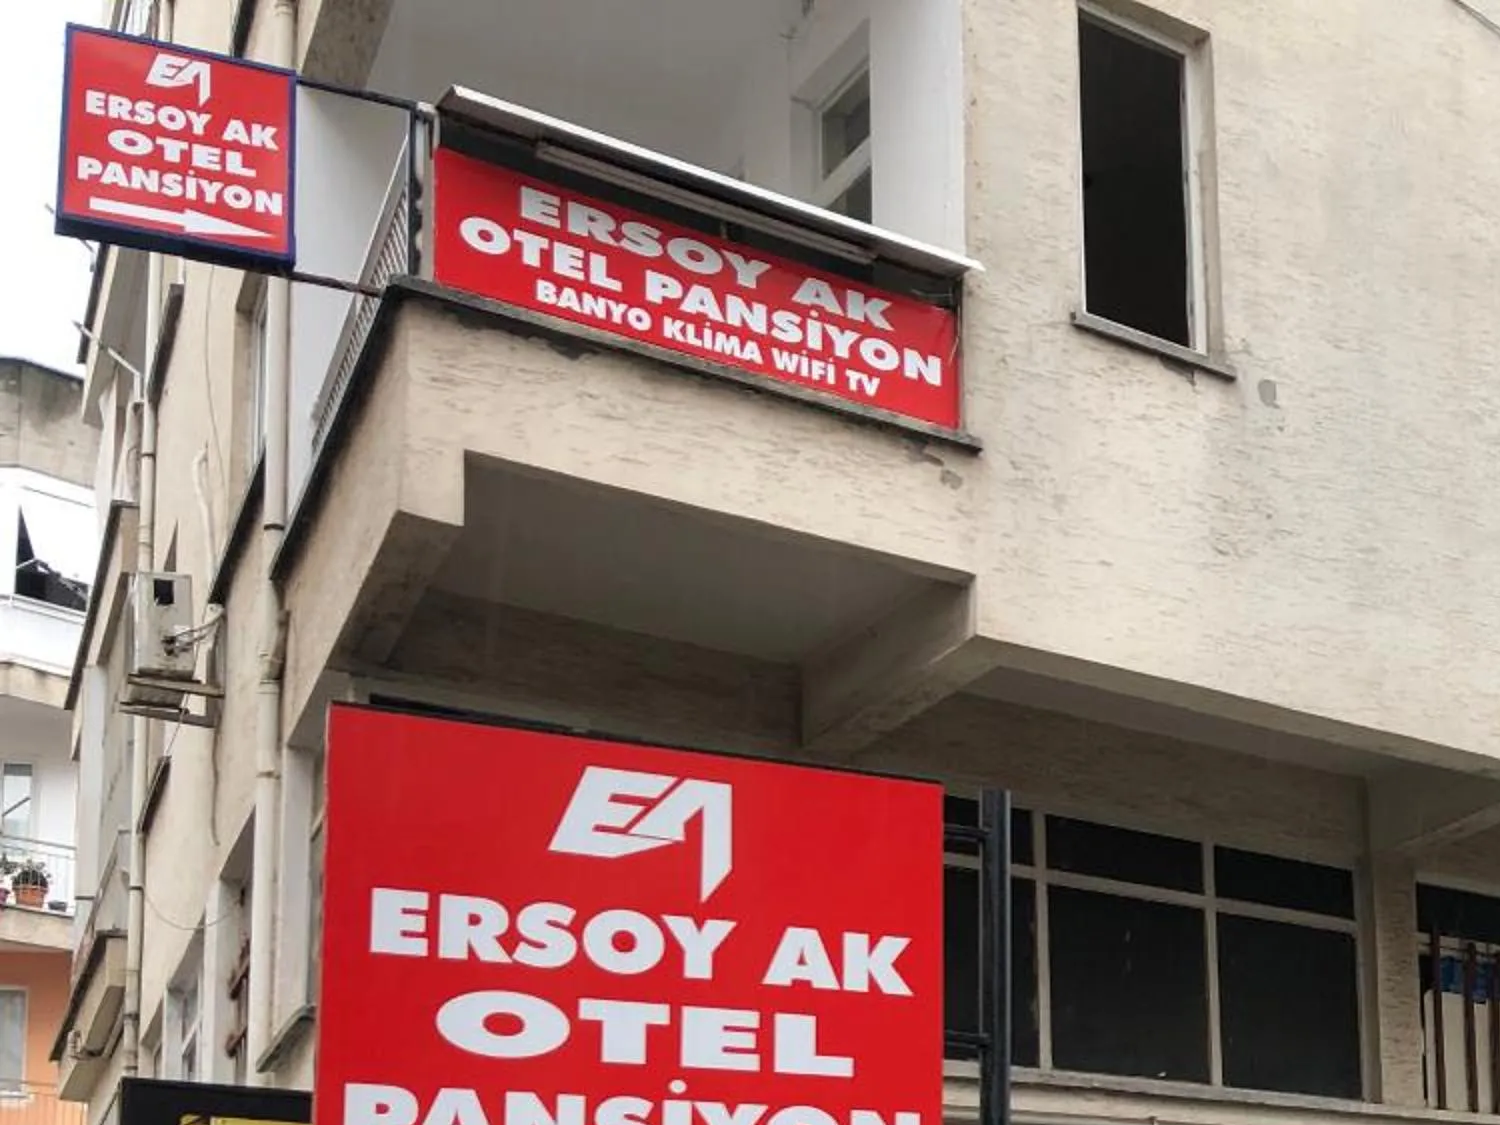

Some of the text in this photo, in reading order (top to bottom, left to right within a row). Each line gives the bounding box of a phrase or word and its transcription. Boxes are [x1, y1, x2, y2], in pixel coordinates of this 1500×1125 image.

[84, 90, 279, 152] ERSOY AK
[107, 127, 257, 179] OTEL
[76, 155, 283, 217] PANSİYON
[458, 216, 943, 388] OTEL PANSİYON
[518, 186, 894, 333] ERSOY AK
[535, 278, 653, 334] BANYO
[660, 310, 764, 366] KLİMA
[845, 368, 882, 398] TV
[369, 887, 914, 997] ERSOY AK
[436, 989, 854, 1078] OTEL
